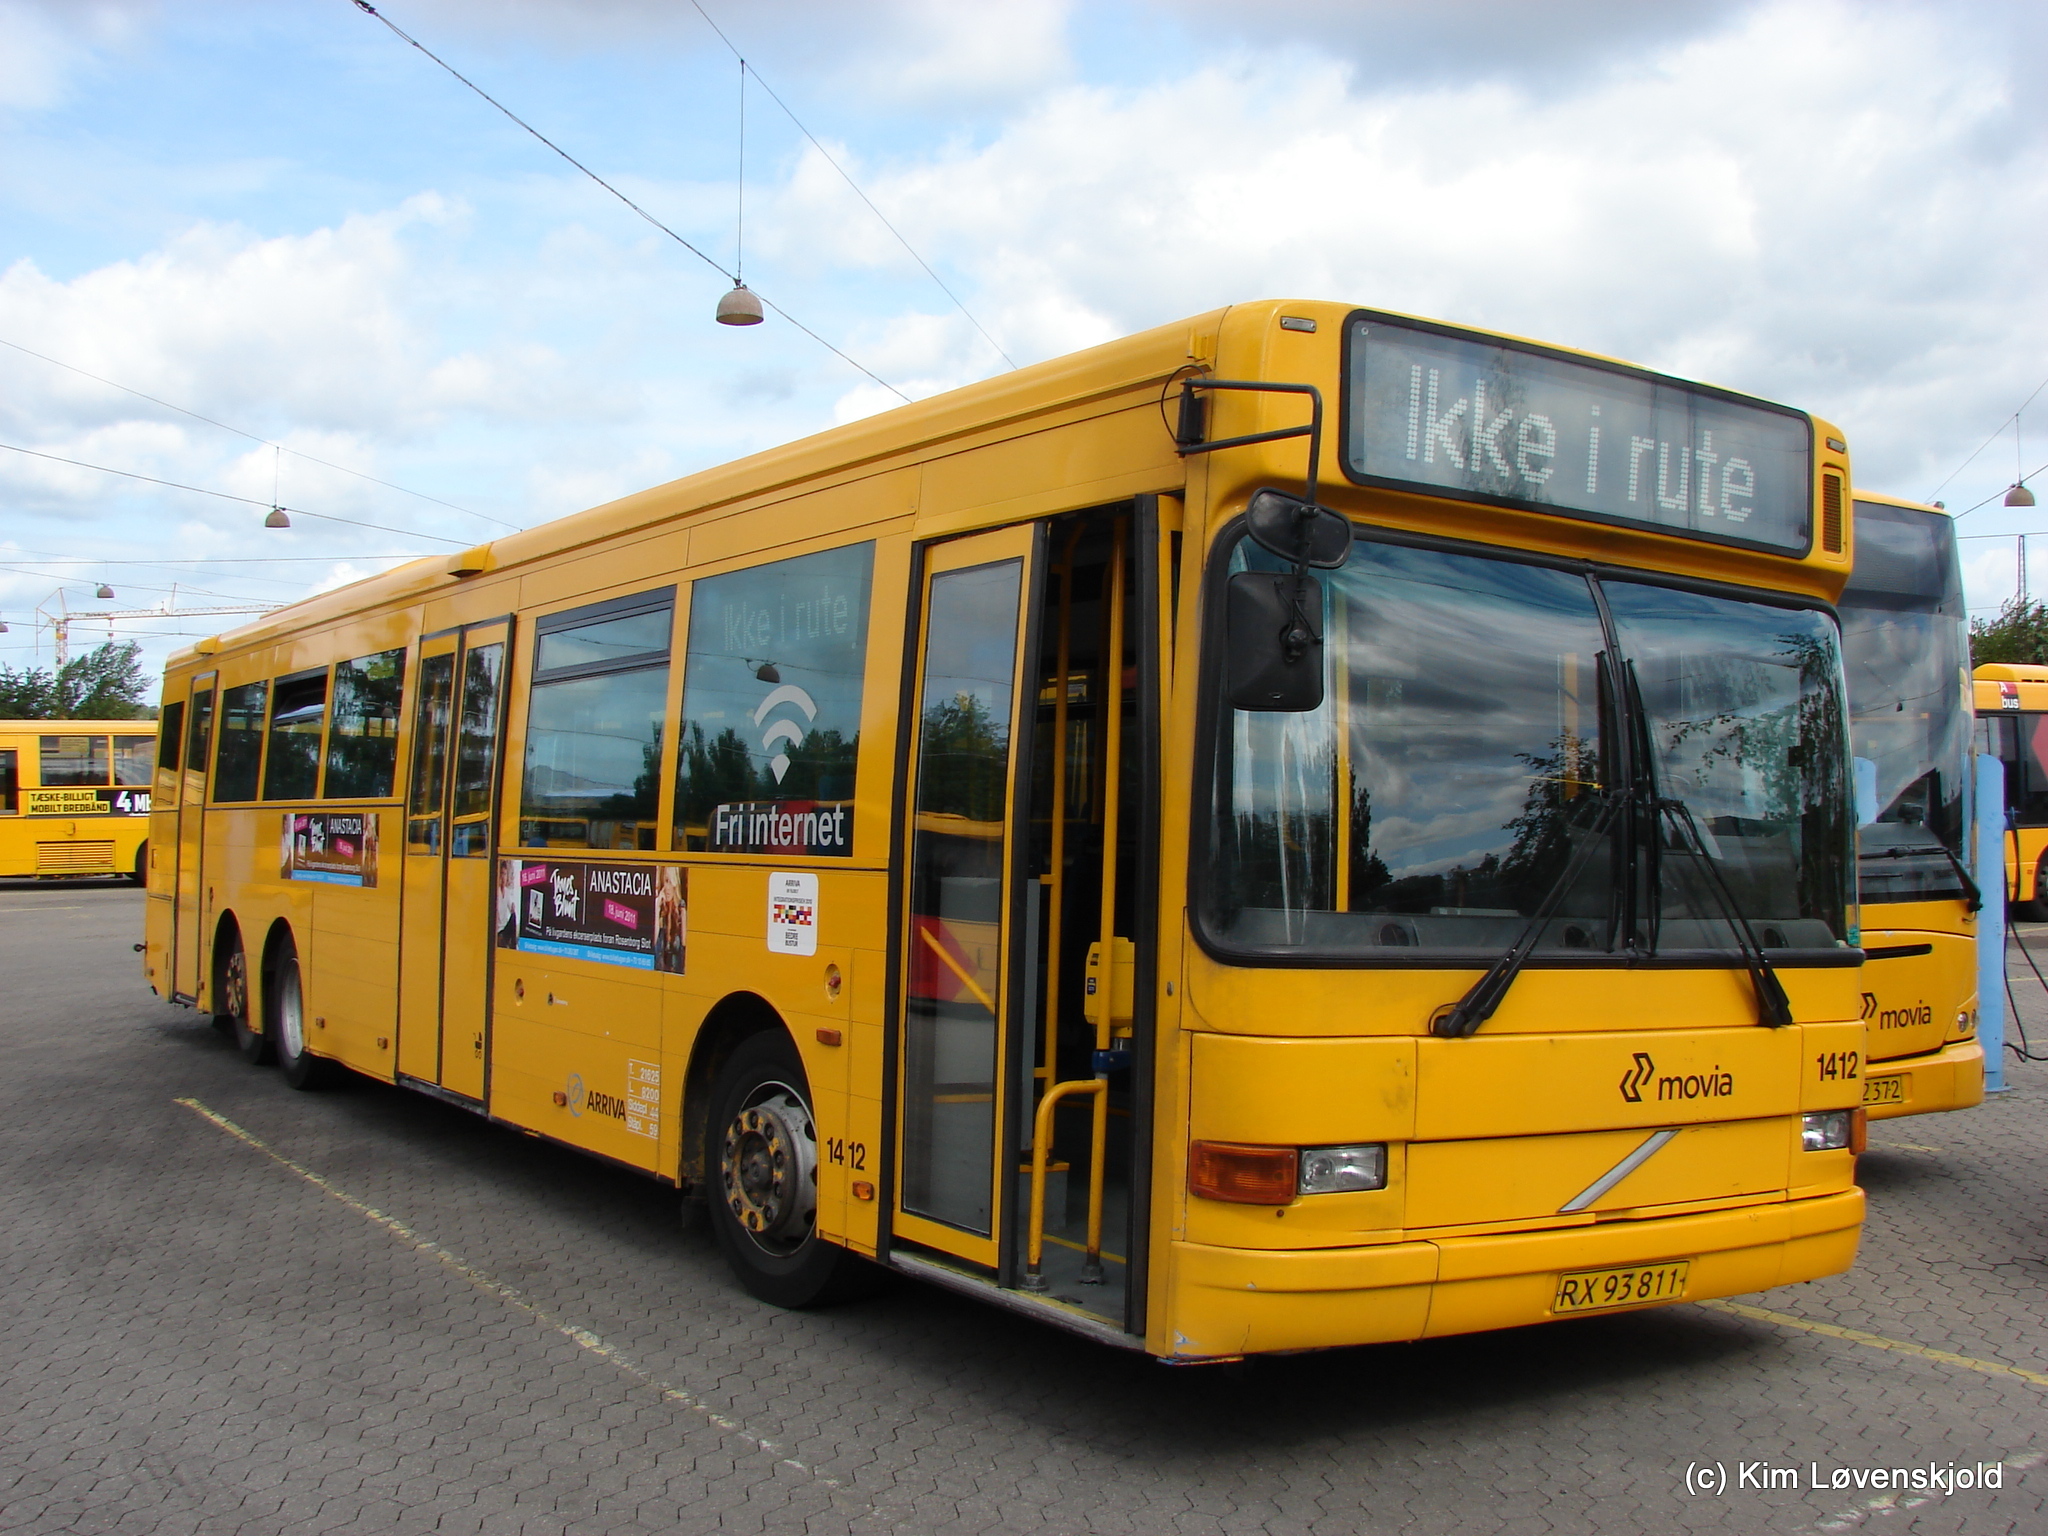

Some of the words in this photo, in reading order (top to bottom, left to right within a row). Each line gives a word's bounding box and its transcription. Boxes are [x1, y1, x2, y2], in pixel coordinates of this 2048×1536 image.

[1406, 364, 1556, 485] Ikke
[1586, 404, 1601, 494] i
[1627, 430, 1755, 522] rute
[724, 601, 770, 651] Ikke
[781, 594, 785, 642] i
[796, 585, 848, 641] rute
[2002, 695, 2019, 709] bus
[31, 793, 94, 802] TÆSKE-BILLIGT
[31, 804, 64, 813] MOBILT
[64, 802, 108, 812] BREDBÅND
[116, 791, 132, 812] 4
[716, 803, 744, 846] Fri
[749, 803, 845, 847] internet
[589, 870, 652, 897] ANASTACIA
[1880, 999, 1931, 1030] movia
[1816, 1051, 1858, 1081] 1412
[1658, 1065, 1733, 1101] movia
[587, 1090, 626, 1121] ARRIVA
[1560, 1277, 1599, 1306] RX
